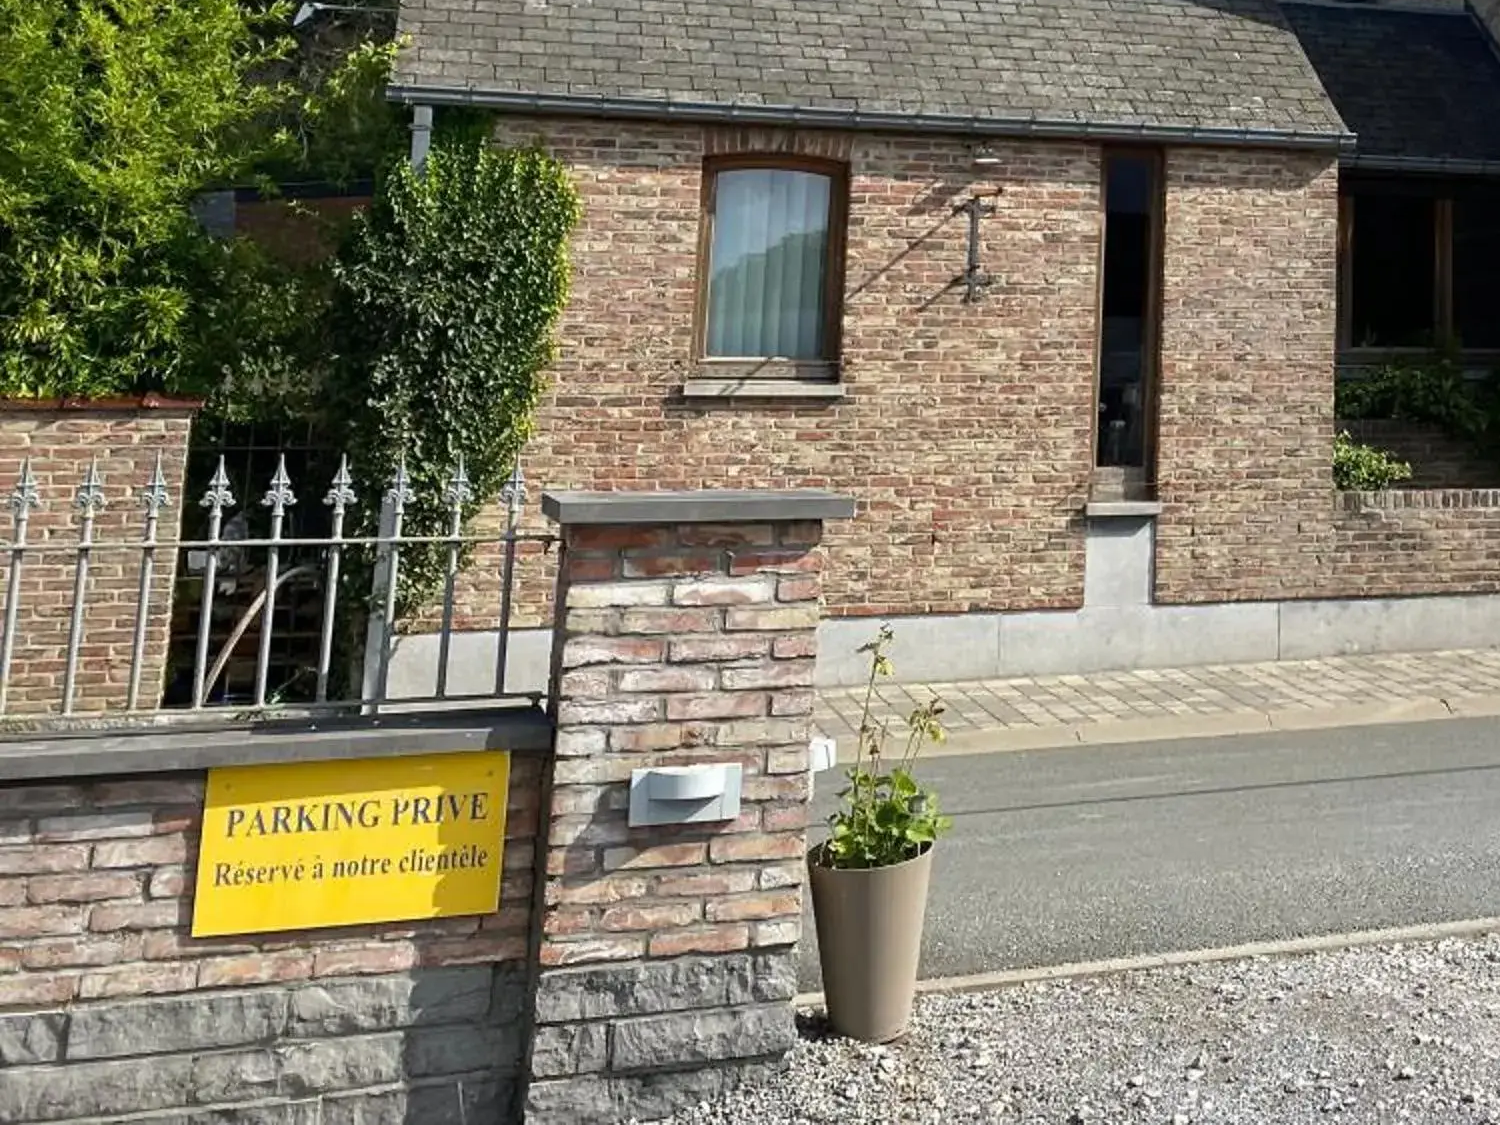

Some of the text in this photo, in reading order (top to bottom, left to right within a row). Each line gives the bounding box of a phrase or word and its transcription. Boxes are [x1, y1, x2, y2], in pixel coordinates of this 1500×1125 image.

[226, 792, 490, 838] PARKING PRIVE
[214, 844, 489, 887] Réservé à notre clientèle
